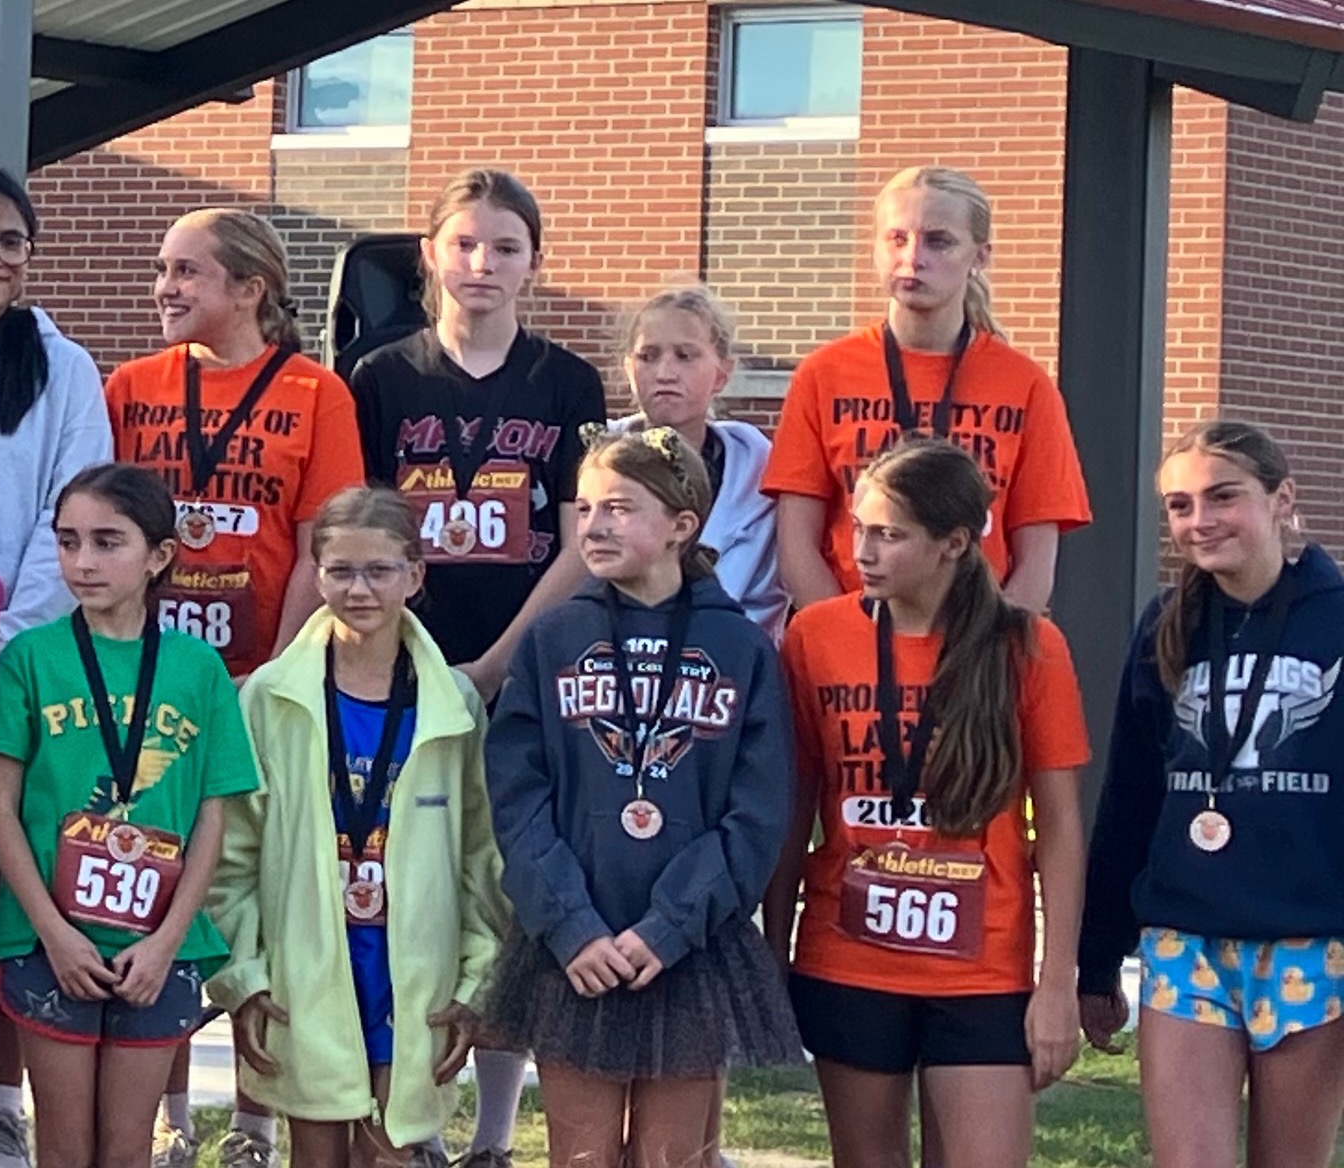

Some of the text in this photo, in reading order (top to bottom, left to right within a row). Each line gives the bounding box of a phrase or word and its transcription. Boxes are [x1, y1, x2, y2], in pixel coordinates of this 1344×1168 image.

[264, 409, 301, 437] OF
[832, 397, 991, 428] PROETY
[133, 430, 265, 469] LAER
[158, 599, 232, 648] 568
[42, 693, 200, 753] PICE
[557, 675, 736, 726] REGOALS
[1261, 770, 1330, 794] FIELD
[74, 854, 161, 919] 539
[864, 883, 959, 943] 566
